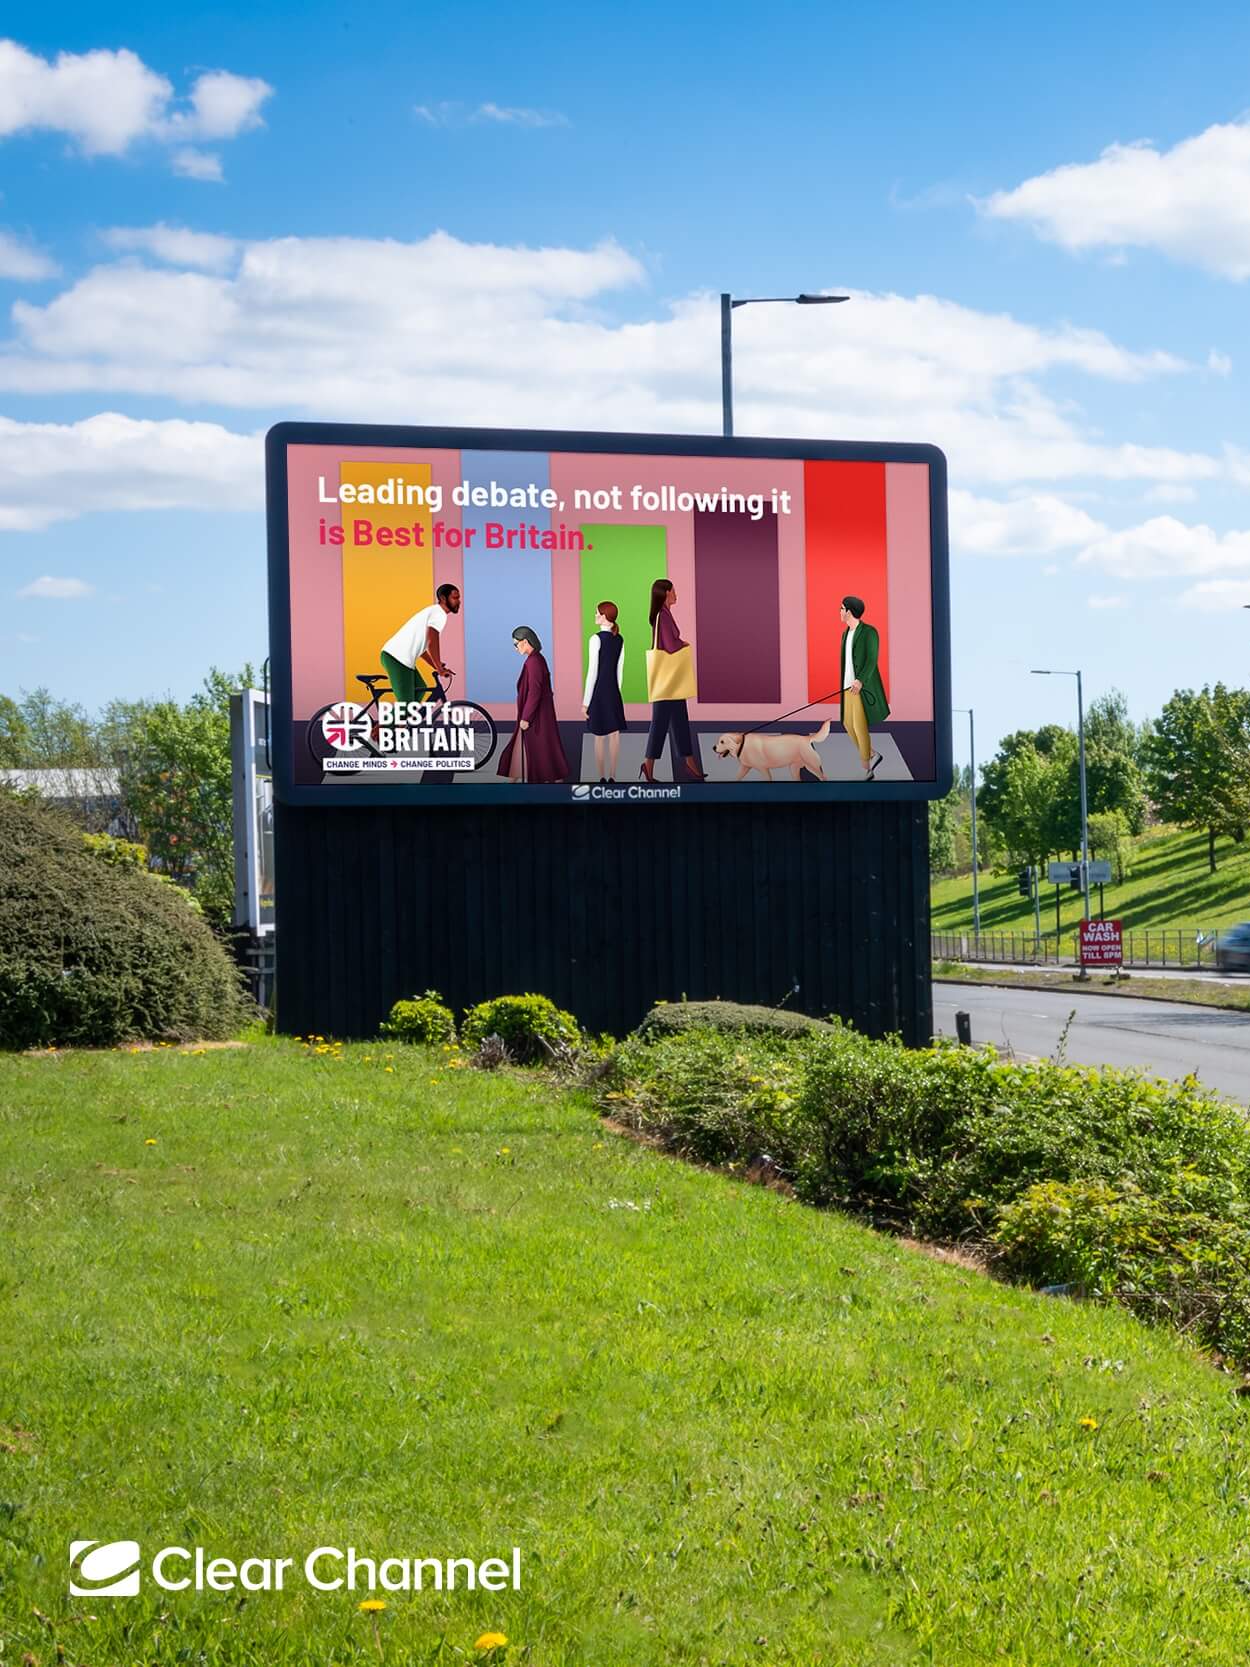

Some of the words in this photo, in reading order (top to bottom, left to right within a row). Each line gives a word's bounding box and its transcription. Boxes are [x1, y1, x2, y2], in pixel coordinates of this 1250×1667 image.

[318, 476, 443, 512] Leading
[451, 480, 565, 512] debate,
[574, 485, 623, 510] not
[630, 485, 765, 520] following
[771, 488, 792, 514] it
[318, 518, 346, 546] is
[353, 519, 425, 547] Best
[433, 521, 477, 548] for
[485, 522, 594, 551] Britain.
[378, 701, 436, 726] BEST
[442, 701, 474, 726] for
[378, 727, 475, 752] BRITAIN
[326, 760, 361, 769] CHANGE
[362, 760, 389, 769] MINDS
[400, 760, 434, 769] CHANGE
[435, 760, 472, 769] POLITICS
[591, 786, 626, 799] Clear
[627, 785, 681, 799] Channel
[1088, 922, 1114, 932] CAR
[1083, 932, 1120, 941] WASH
[1082, 951, 1101, 959] TILL
